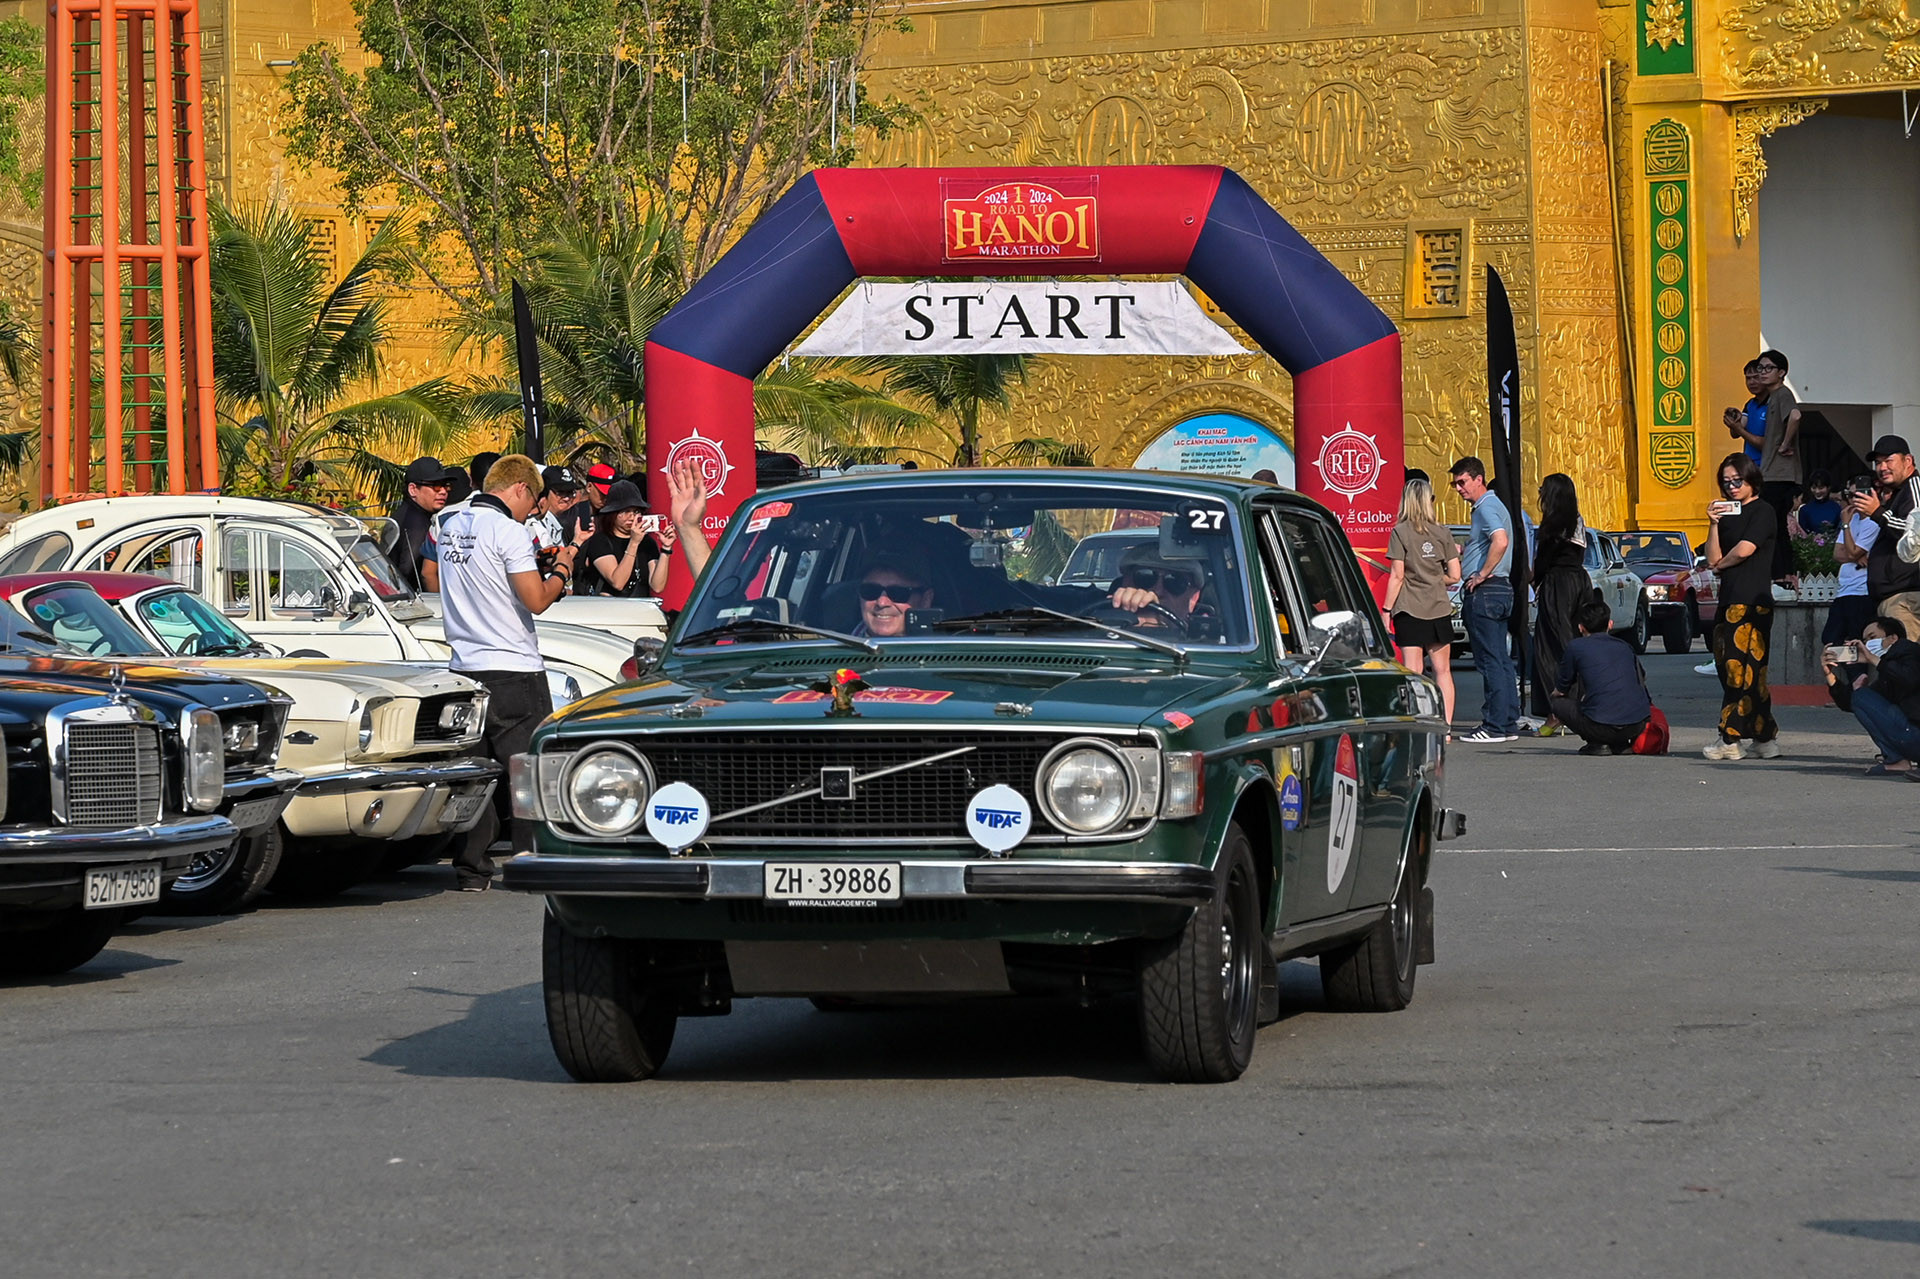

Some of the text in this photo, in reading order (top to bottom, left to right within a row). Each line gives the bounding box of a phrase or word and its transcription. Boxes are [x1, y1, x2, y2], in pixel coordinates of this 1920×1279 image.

[984, 186, 1053, 204] 2024 1 2024
[990, 204, 1048, 215] ROAD TO
[952, 204, 1090, 250] HANOI
[978, 245, 1060, 256] MARATHON
[904, 294, 1136, 342] START
[1331, 449, 1371, 477] RTG
[1188, 509, 1225, 530] 27
[1357, 511, 1392, 524] Globe
[443, 550, 472, 565] CREW
[654, 806, 699, 825] WIPAC
[975, 810, 1022, 829] WIPAC
